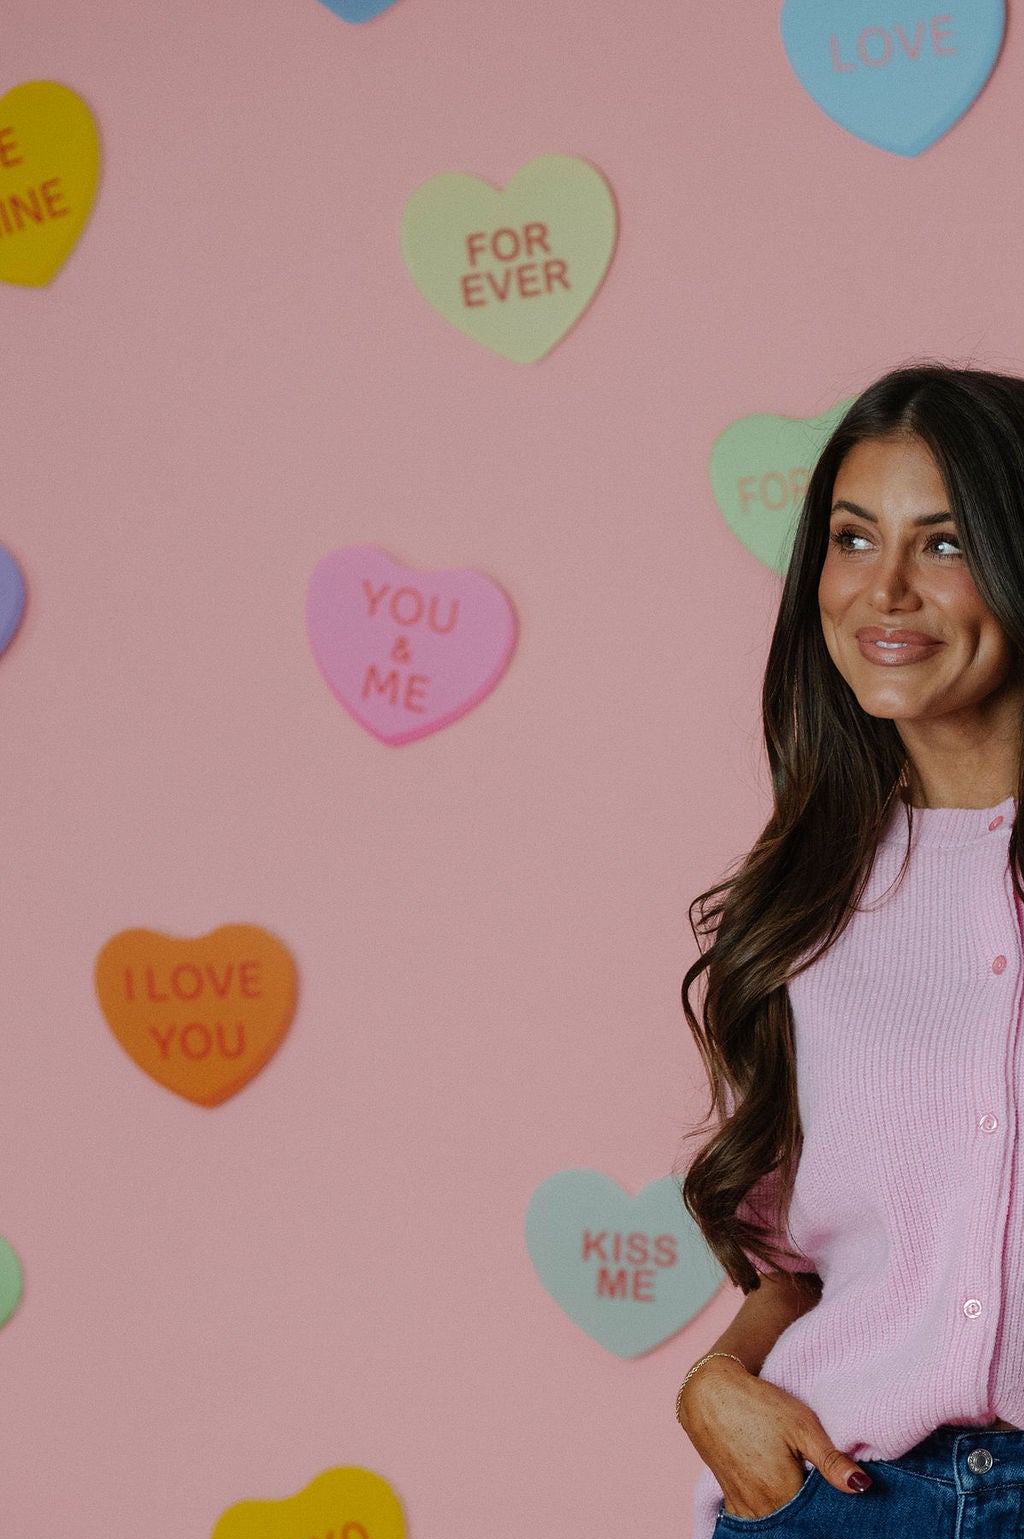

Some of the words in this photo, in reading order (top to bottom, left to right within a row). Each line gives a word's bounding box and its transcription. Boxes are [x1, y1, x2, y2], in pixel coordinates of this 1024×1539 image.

[829, 13, 957, 72] LOVE
[0, 126, 23, 169] E
[0, 177, 70, 240] INE
[466, 222, 549, 266] FOR
[461, 259, 570, 308] EVER
[362, 578, 458, 636] YOU
[390, 635, 413, 666] &
[360, 665, 426, 714] ME
[123, 965, 137, 1003] I
[147, 962, 263, 1003] LOVE
[148, 1021, 246, 1060] YOU
[582, 1229, 675, 1268] KISS
[596, 1266, 655, 1302] ME
